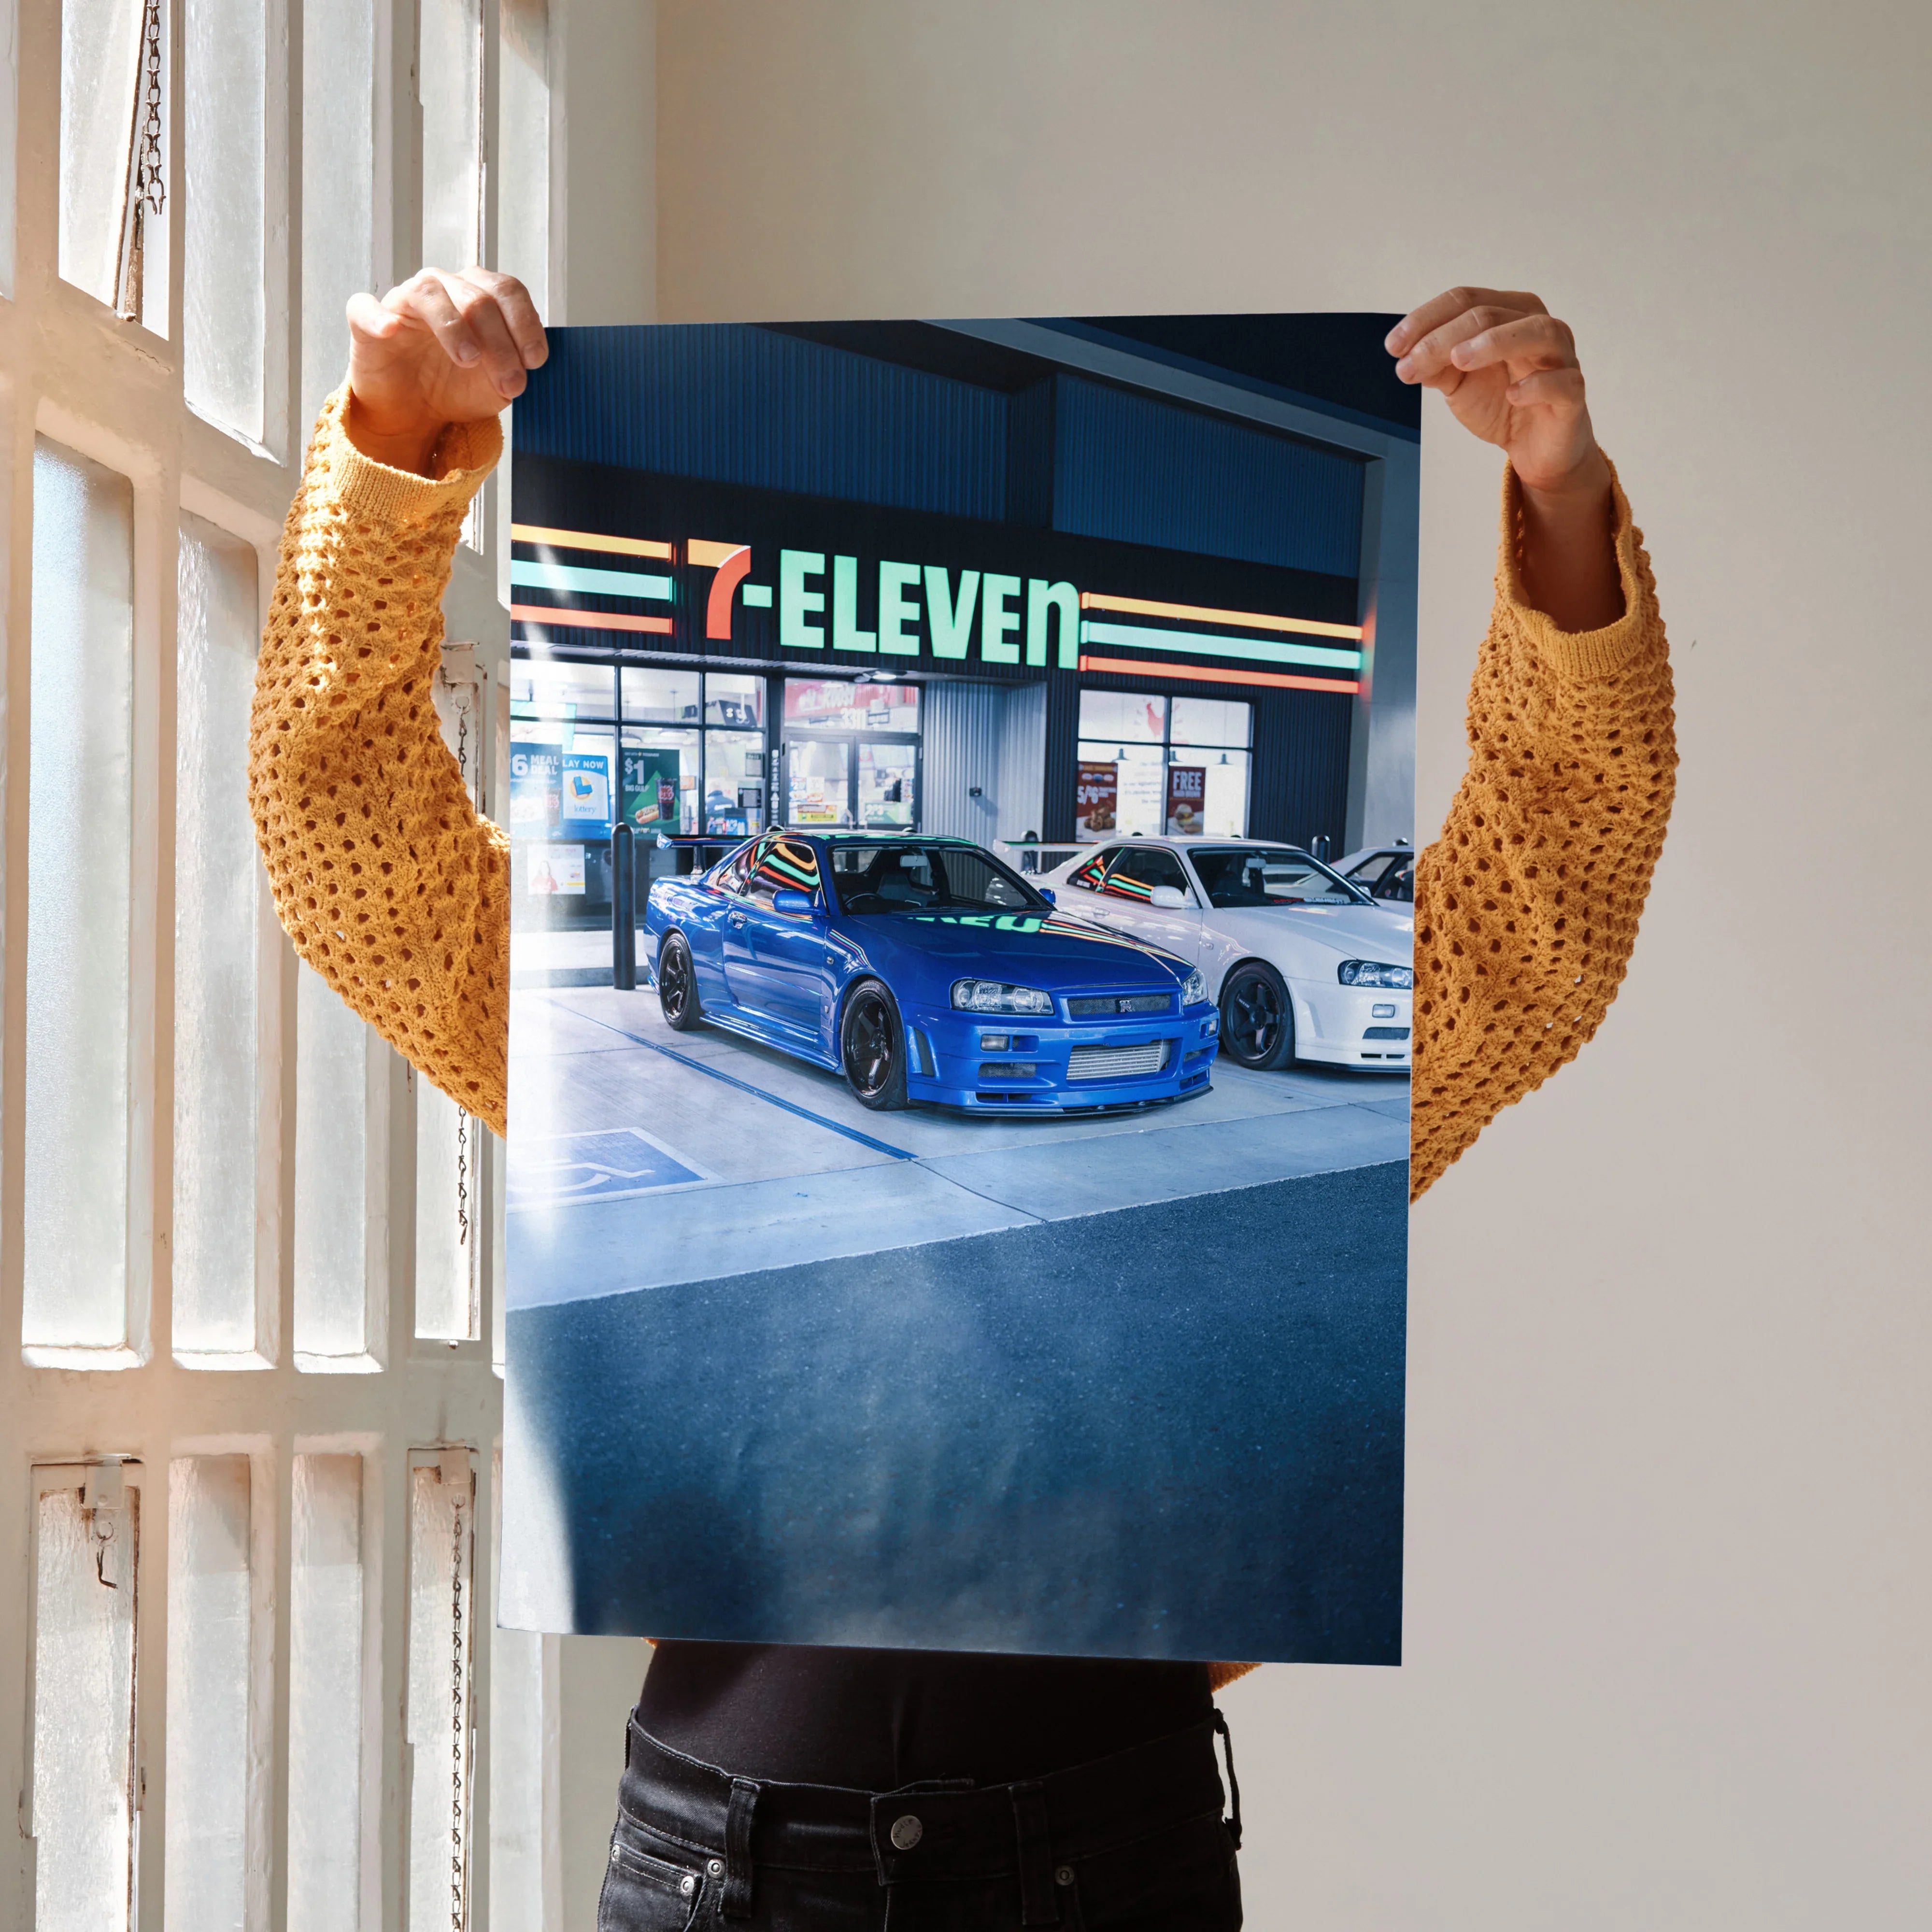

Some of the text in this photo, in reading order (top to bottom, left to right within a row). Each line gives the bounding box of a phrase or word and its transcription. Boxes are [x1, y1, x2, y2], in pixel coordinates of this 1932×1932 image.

[688, 539, 1080, 669] 7-ELEVEn
[511, 754, 528, 776] 6
[531, 754, 560, 765] MEAL
[562, 759, 604, 769] LAY NOW
[531, 765, 558, 775] DEAL
[625, 757, 644, 785] $1
[1173, 771, 1202, 790] FREE
